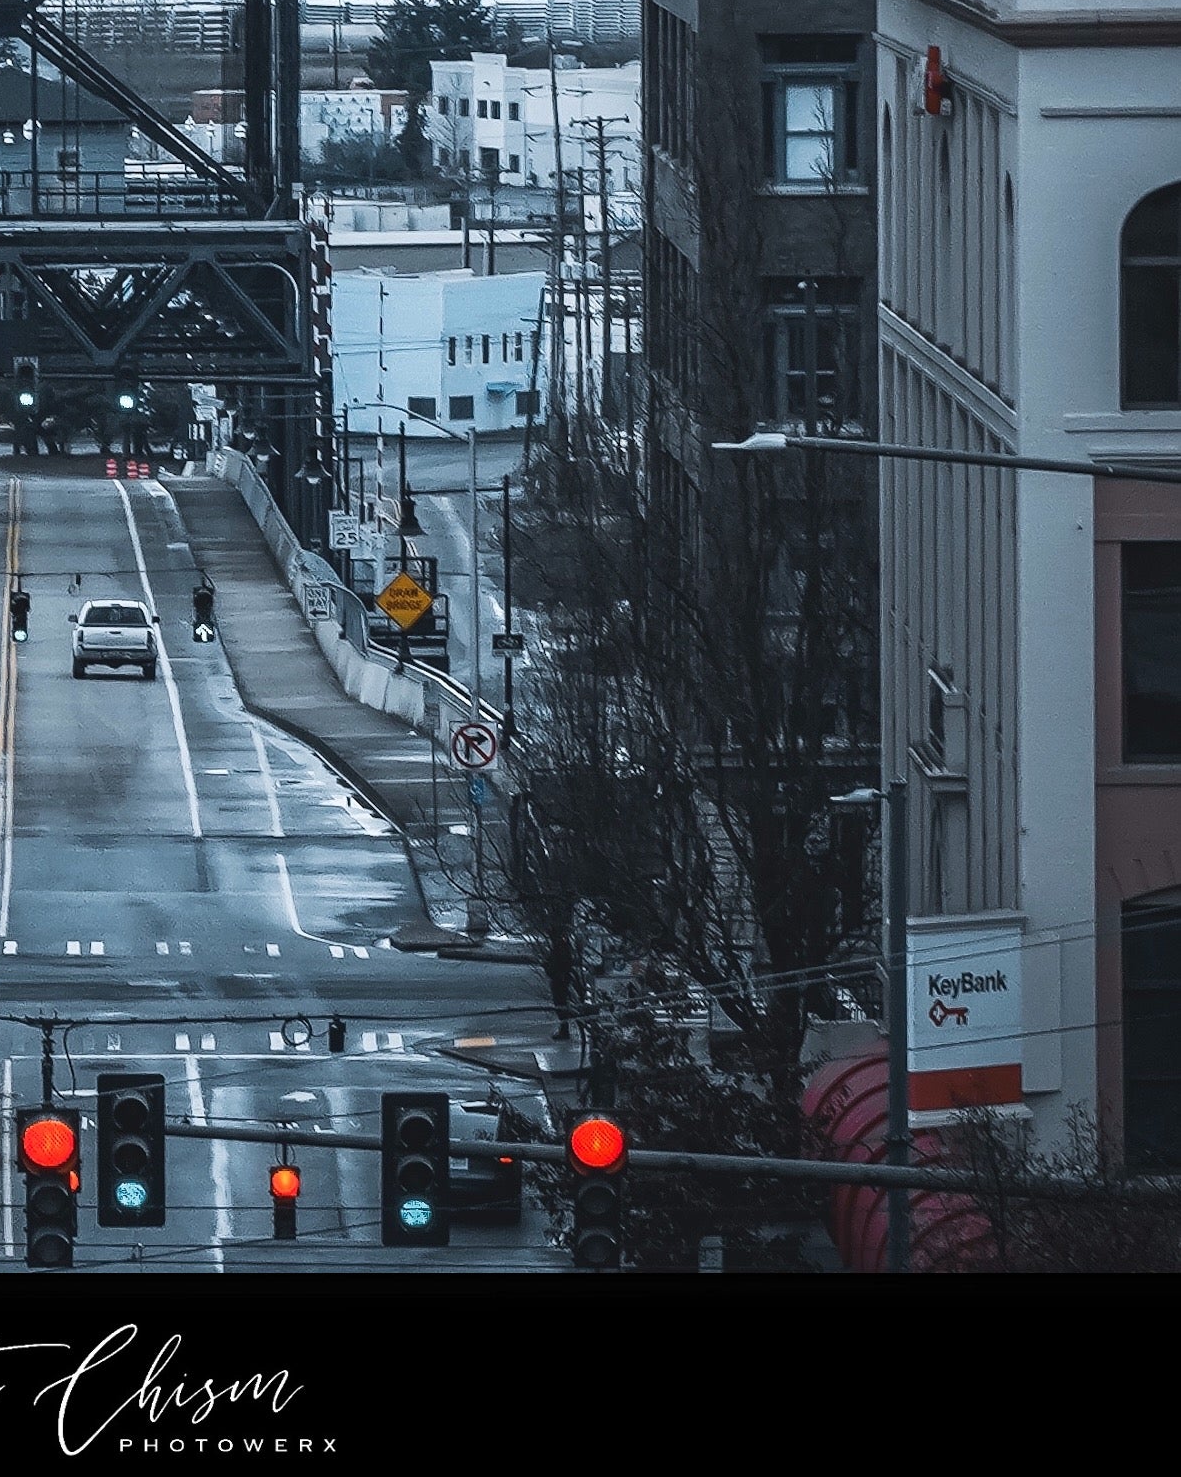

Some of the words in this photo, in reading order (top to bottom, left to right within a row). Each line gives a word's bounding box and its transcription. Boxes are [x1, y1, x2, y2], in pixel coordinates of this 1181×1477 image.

[336, 532, 358, 545] 25
[307, 588, 328, 598] ONE
[307, 598, 328, 607] WAY
[928, 971, 1007, 998] KeyBank
